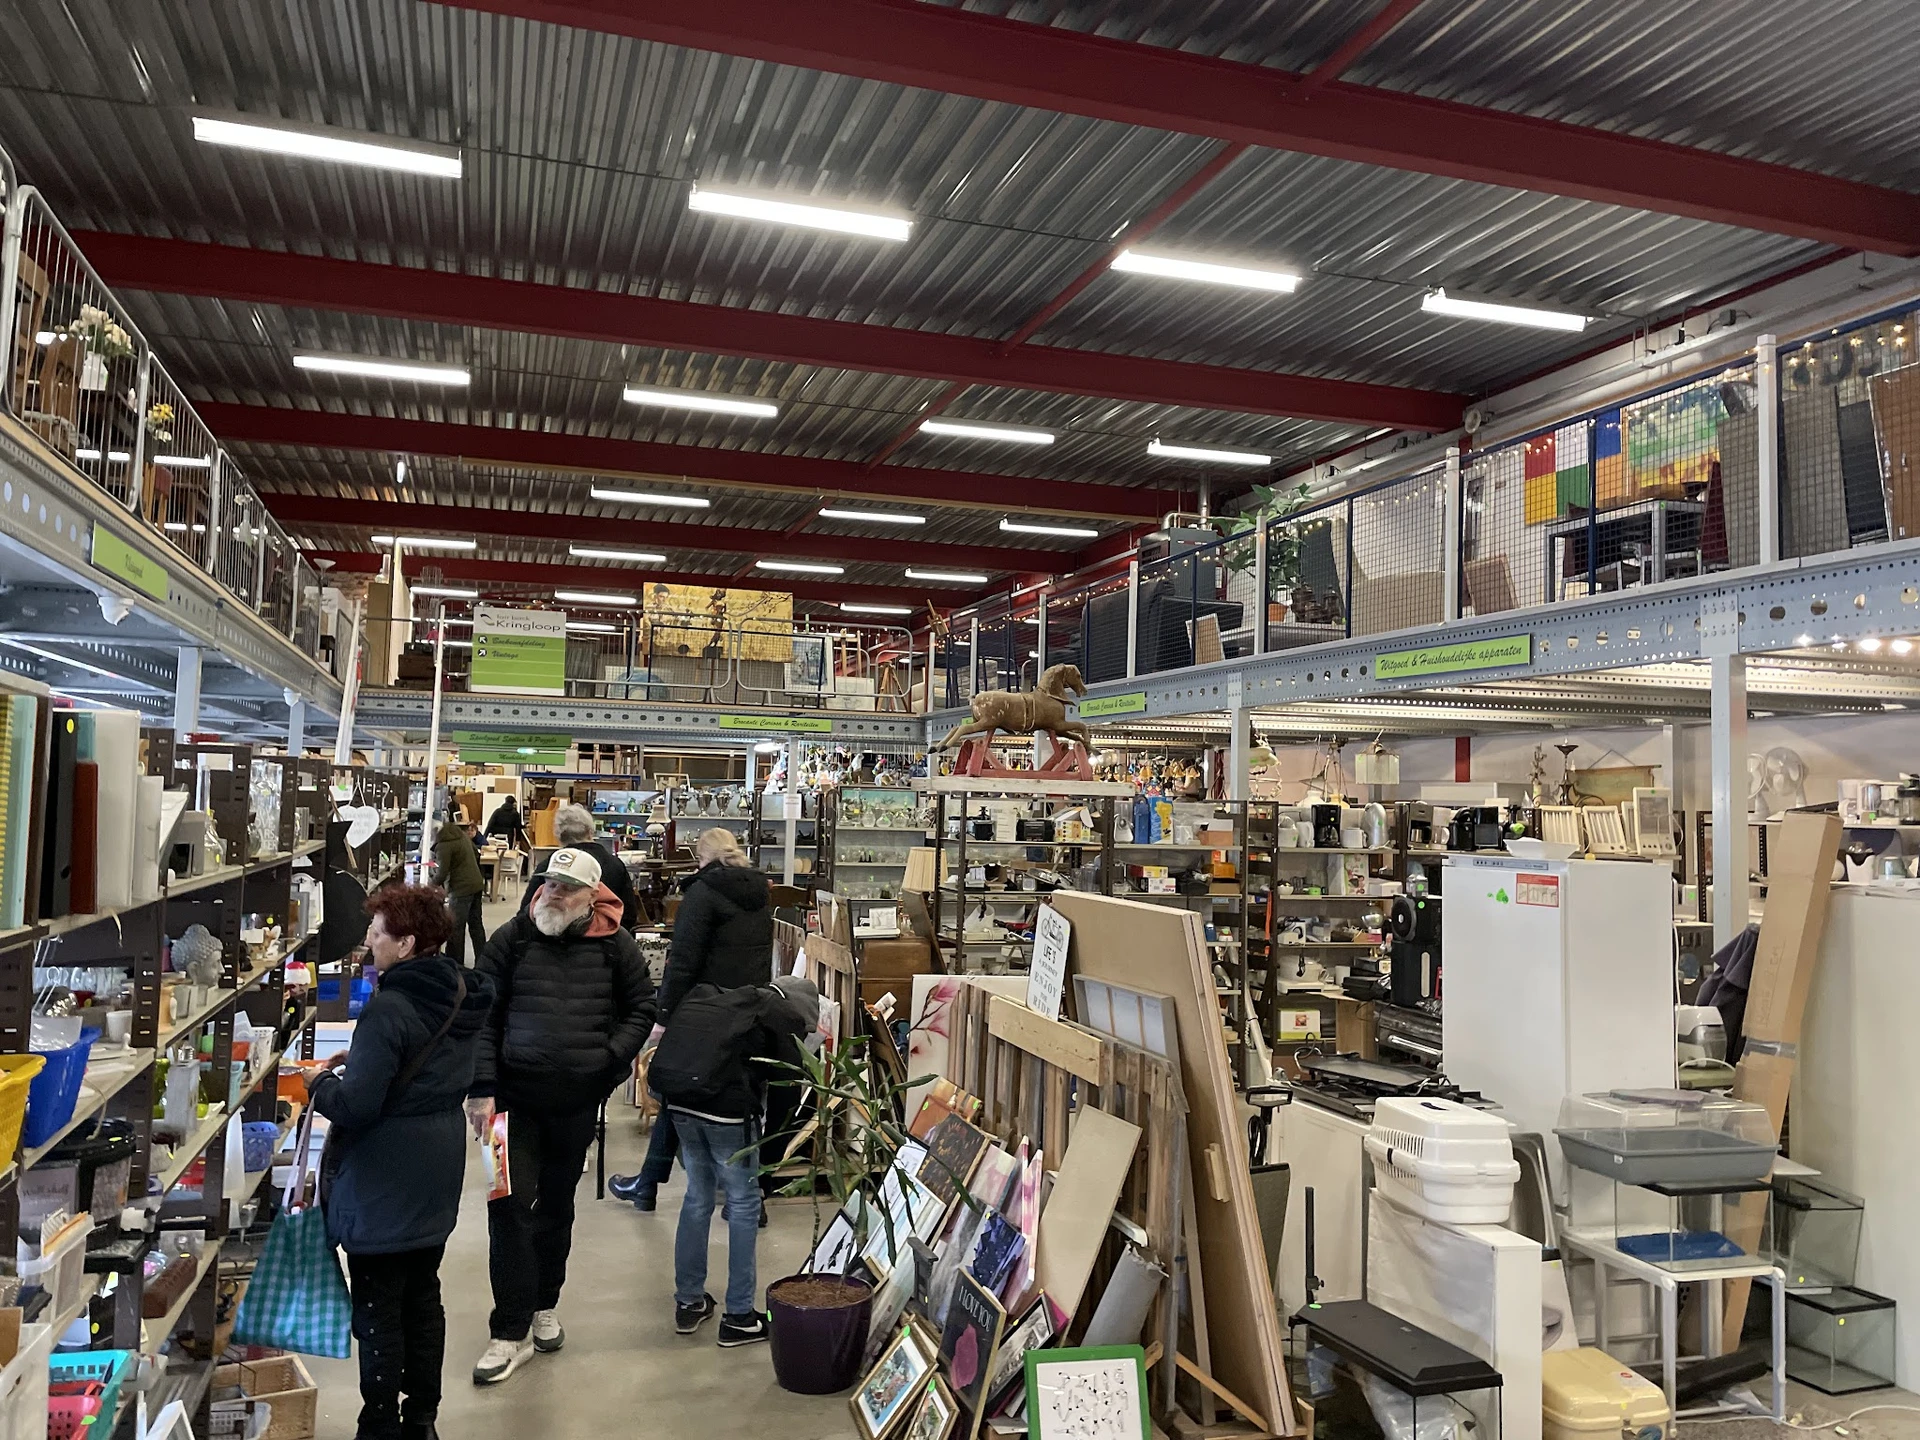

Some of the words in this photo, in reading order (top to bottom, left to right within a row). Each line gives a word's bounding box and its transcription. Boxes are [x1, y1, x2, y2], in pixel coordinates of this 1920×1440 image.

[496, 620, 561, 633] Kringloop
[492, 637, 546, 648] Boekenafdeling
[491, 650, 519, 659] Vintage
[1380, 659, 1409, 674] Witgoed
[1411, 655, 1418, 667] &
[1420, 650, 1477, 667] Huishoudelijke
[1478, 645, 1522, 663] apparaten
[759, 719, 782, 727] Curiosa
[791, 720, 819, 728] Rariteiten
[469, 733, 500, 742] Speelgoed
[1034, 971, 1058, 998] ENJOY
[958, 1285, 964, 1302] I
[962, 1289, 980, 1318] LOVE
[977, 1305, 994, 1332] YOU
